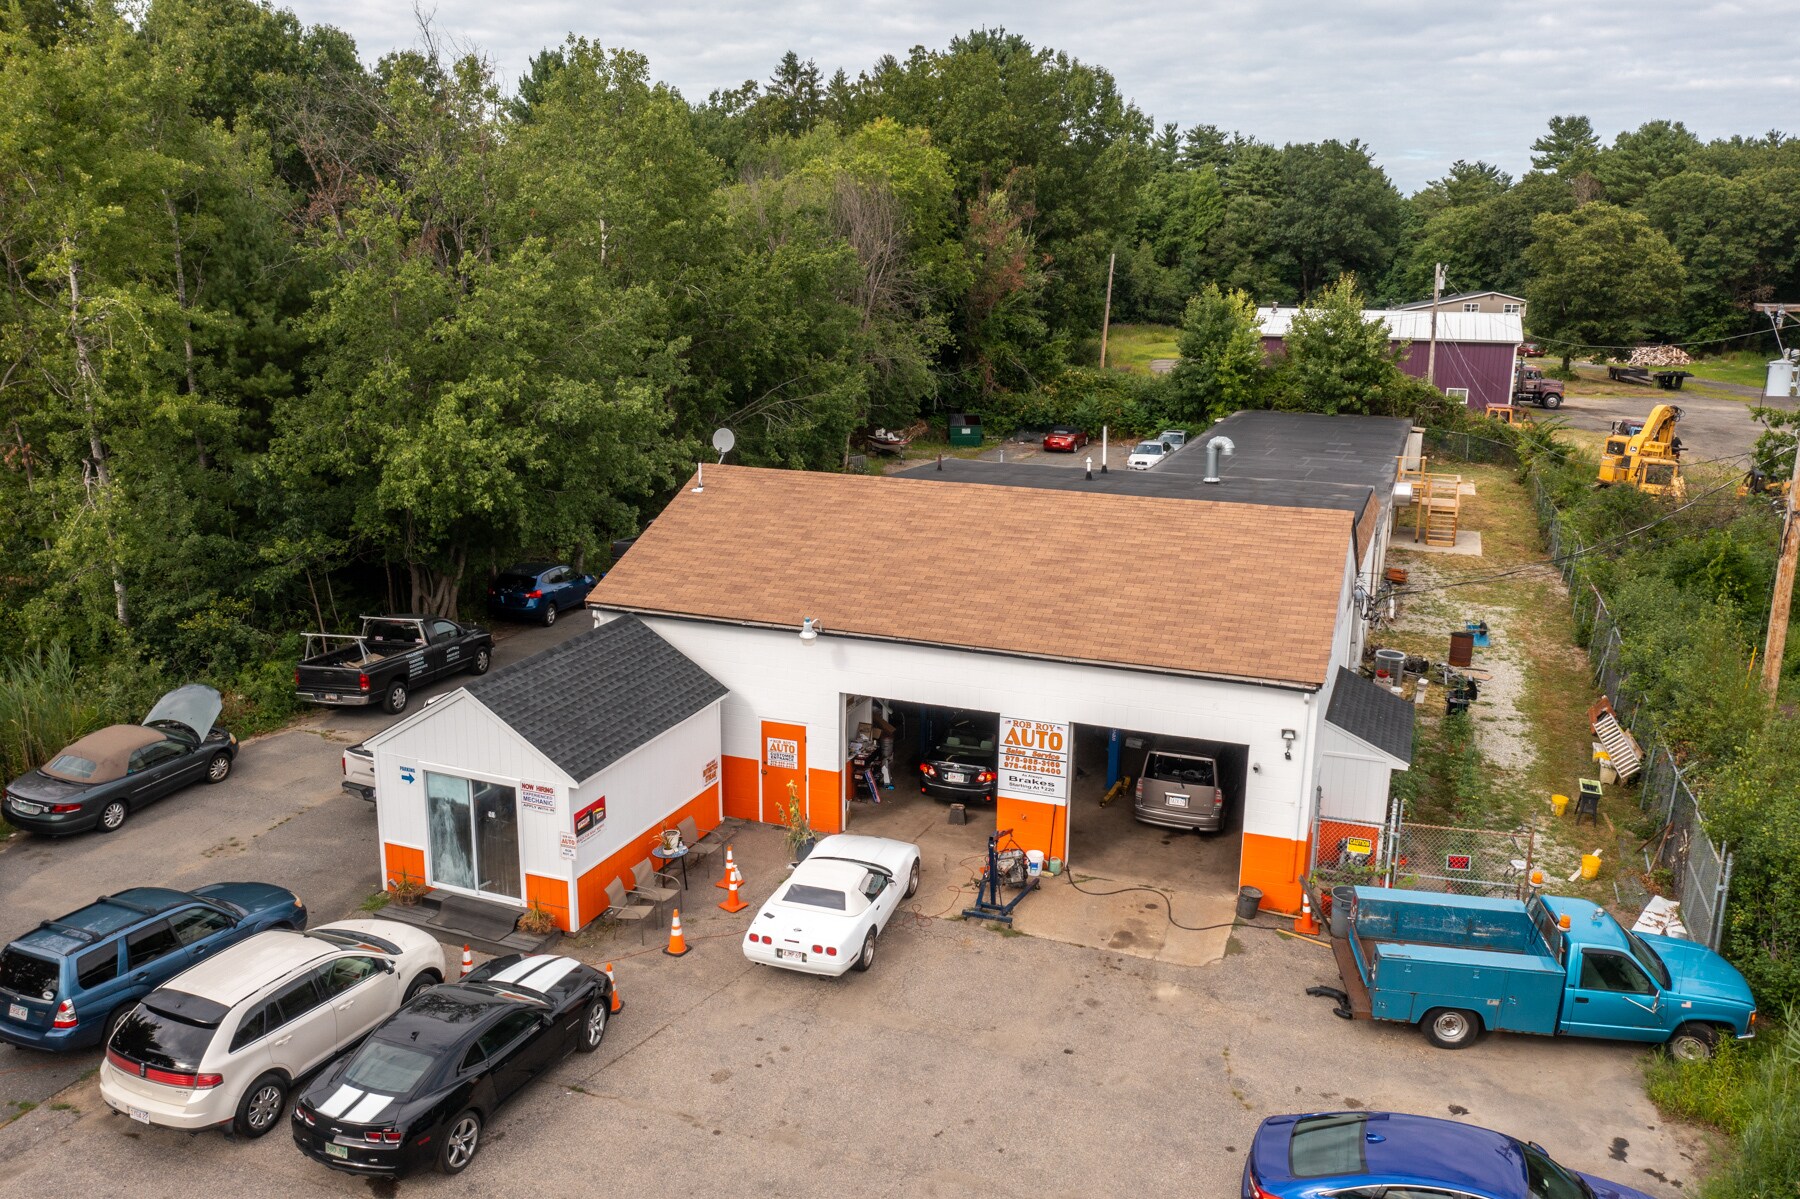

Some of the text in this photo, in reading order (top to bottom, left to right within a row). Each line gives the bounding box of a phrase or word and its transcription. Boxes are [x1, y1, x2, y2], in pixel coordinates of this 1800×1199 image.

[1012, 720, 1055, 731] ROB ROY
[1004, 727, 1063, 751] AUTO
[770, 743, 795, 754] AUTO
[1006, 747, 1060, 760] Sales Service
[400, 765, 415, 773] PARKING
[1008, 775, 1055, 787] Brakes
[1009, 782, 1032, 790] Starting
[536, 785, 553, 794] HIRING
[523, 791, 553, 800] EXPERIENCED
[523, 796, 553, 806] MECHANIC
